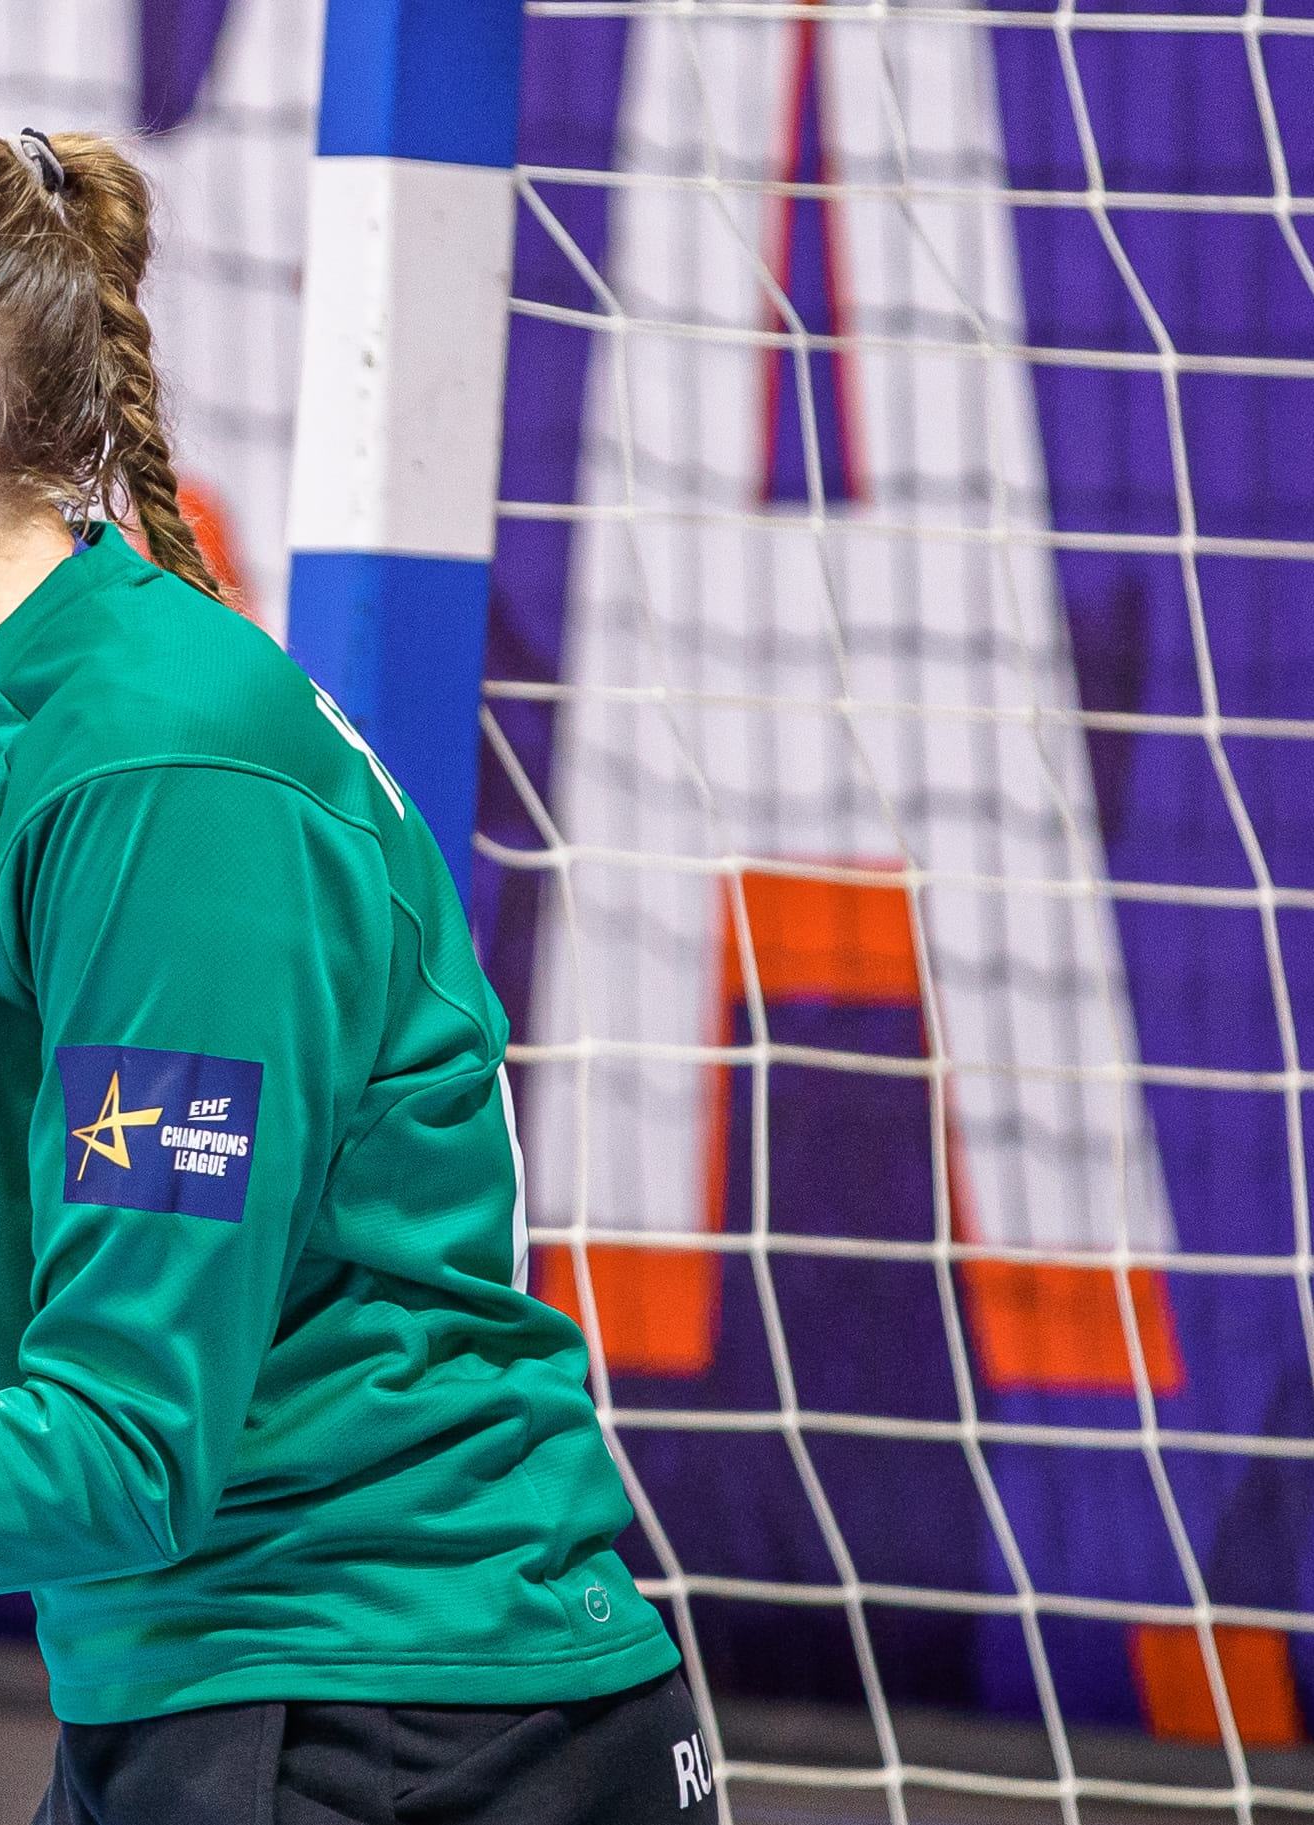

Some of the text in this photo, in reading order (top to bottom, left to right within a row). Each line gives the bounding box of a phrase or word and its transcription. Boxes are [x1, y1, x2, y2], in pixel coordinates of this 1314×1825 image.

[188, 1097, 232, 1118] EHF
[160, 1125, 249, 1157] CHAMPIONS
[174, 1150, 228, 1177] LEAGUE
